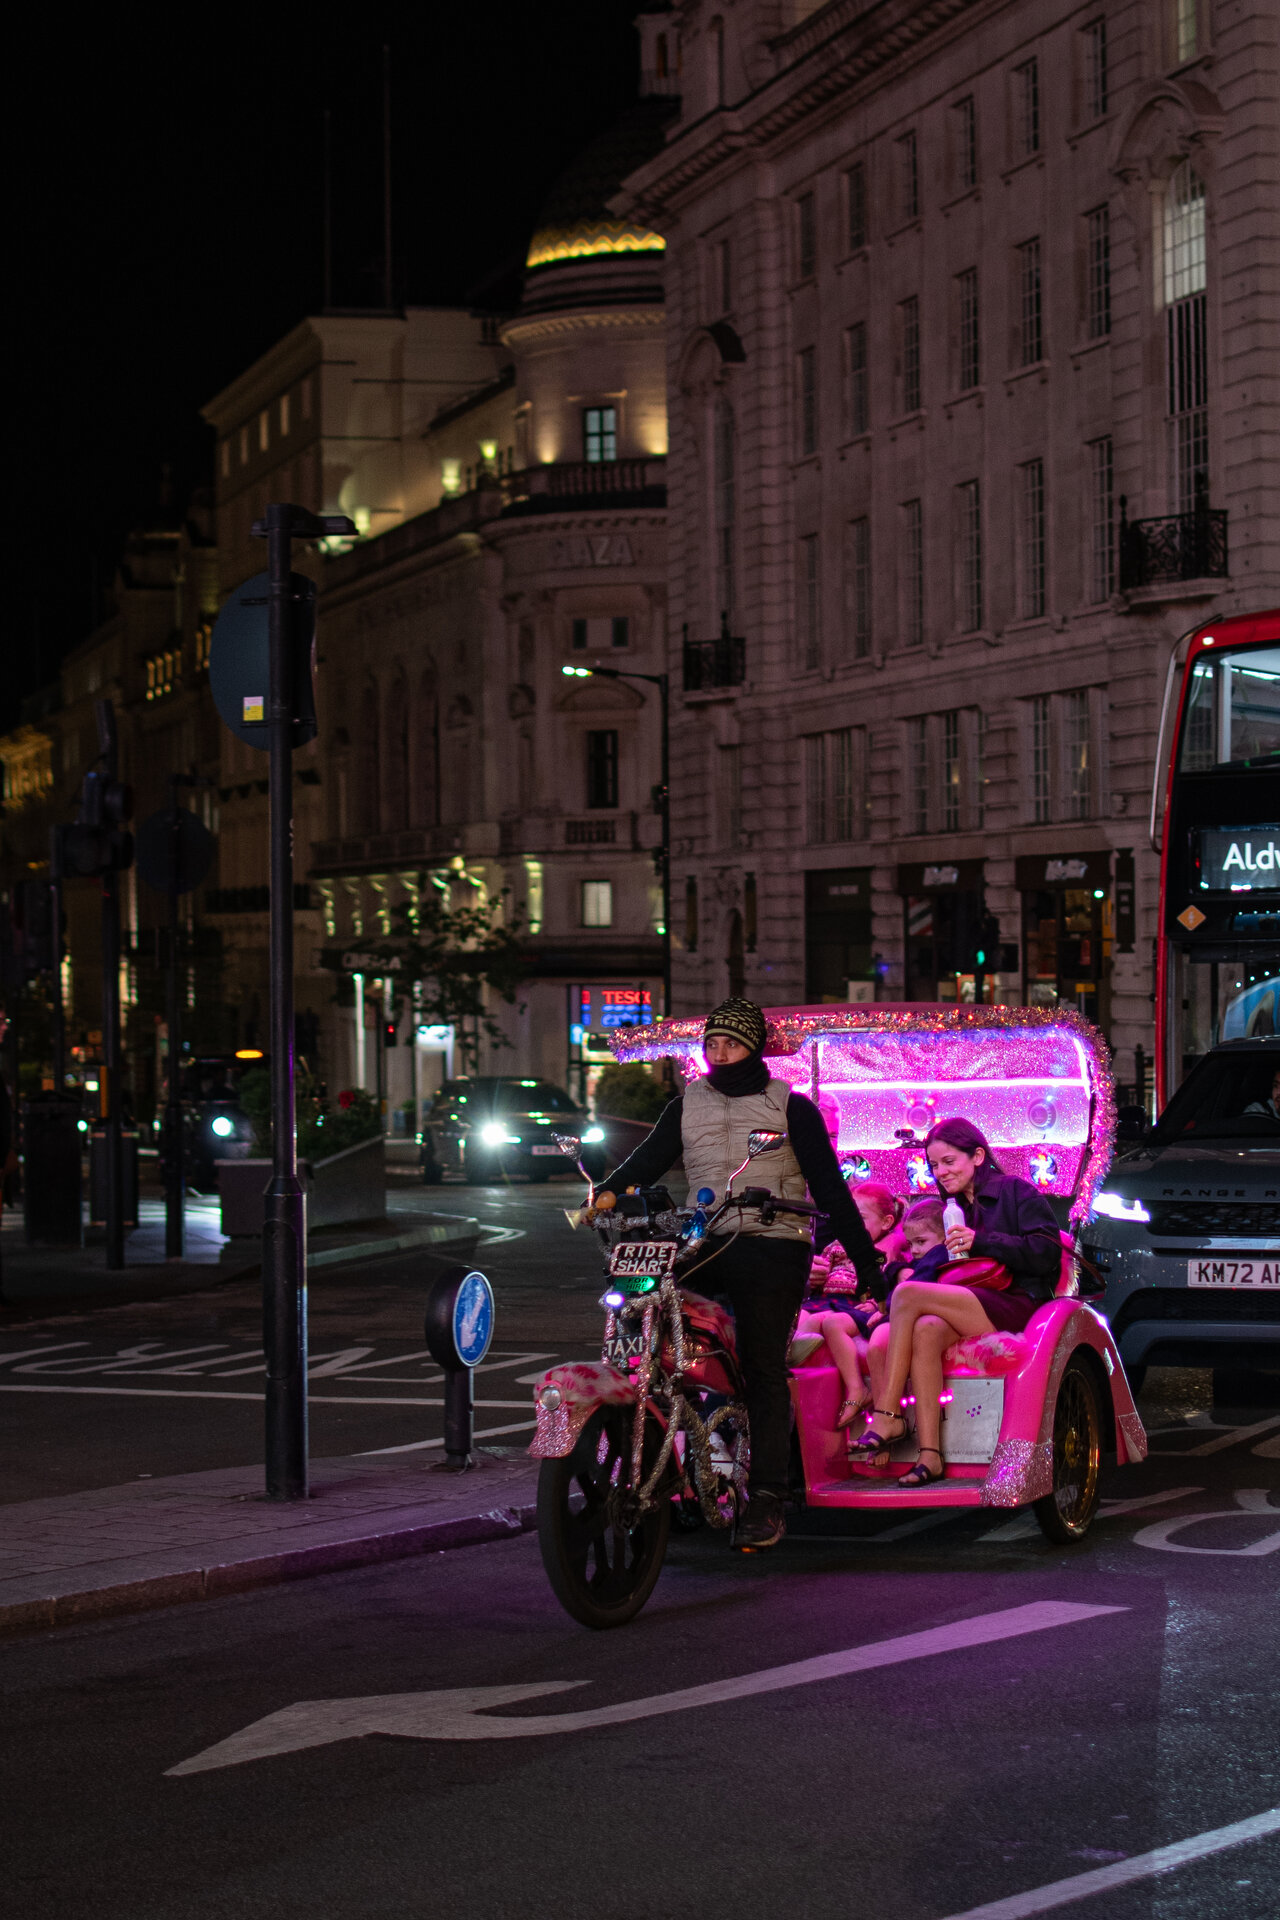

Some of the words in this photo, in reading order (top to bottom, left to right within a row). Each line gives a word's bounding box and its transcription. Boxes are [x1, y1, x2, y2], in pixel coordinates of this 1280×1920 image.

[713, 1019, 761, 1044] REEBOK
[1162, 1189, 1247, 1197] RANGE
[624, 1246, 669, 1258] RIDE
[1198, 1262, 1253, 1283] KM72
[605, 1336, 644, 1356] TAXI
